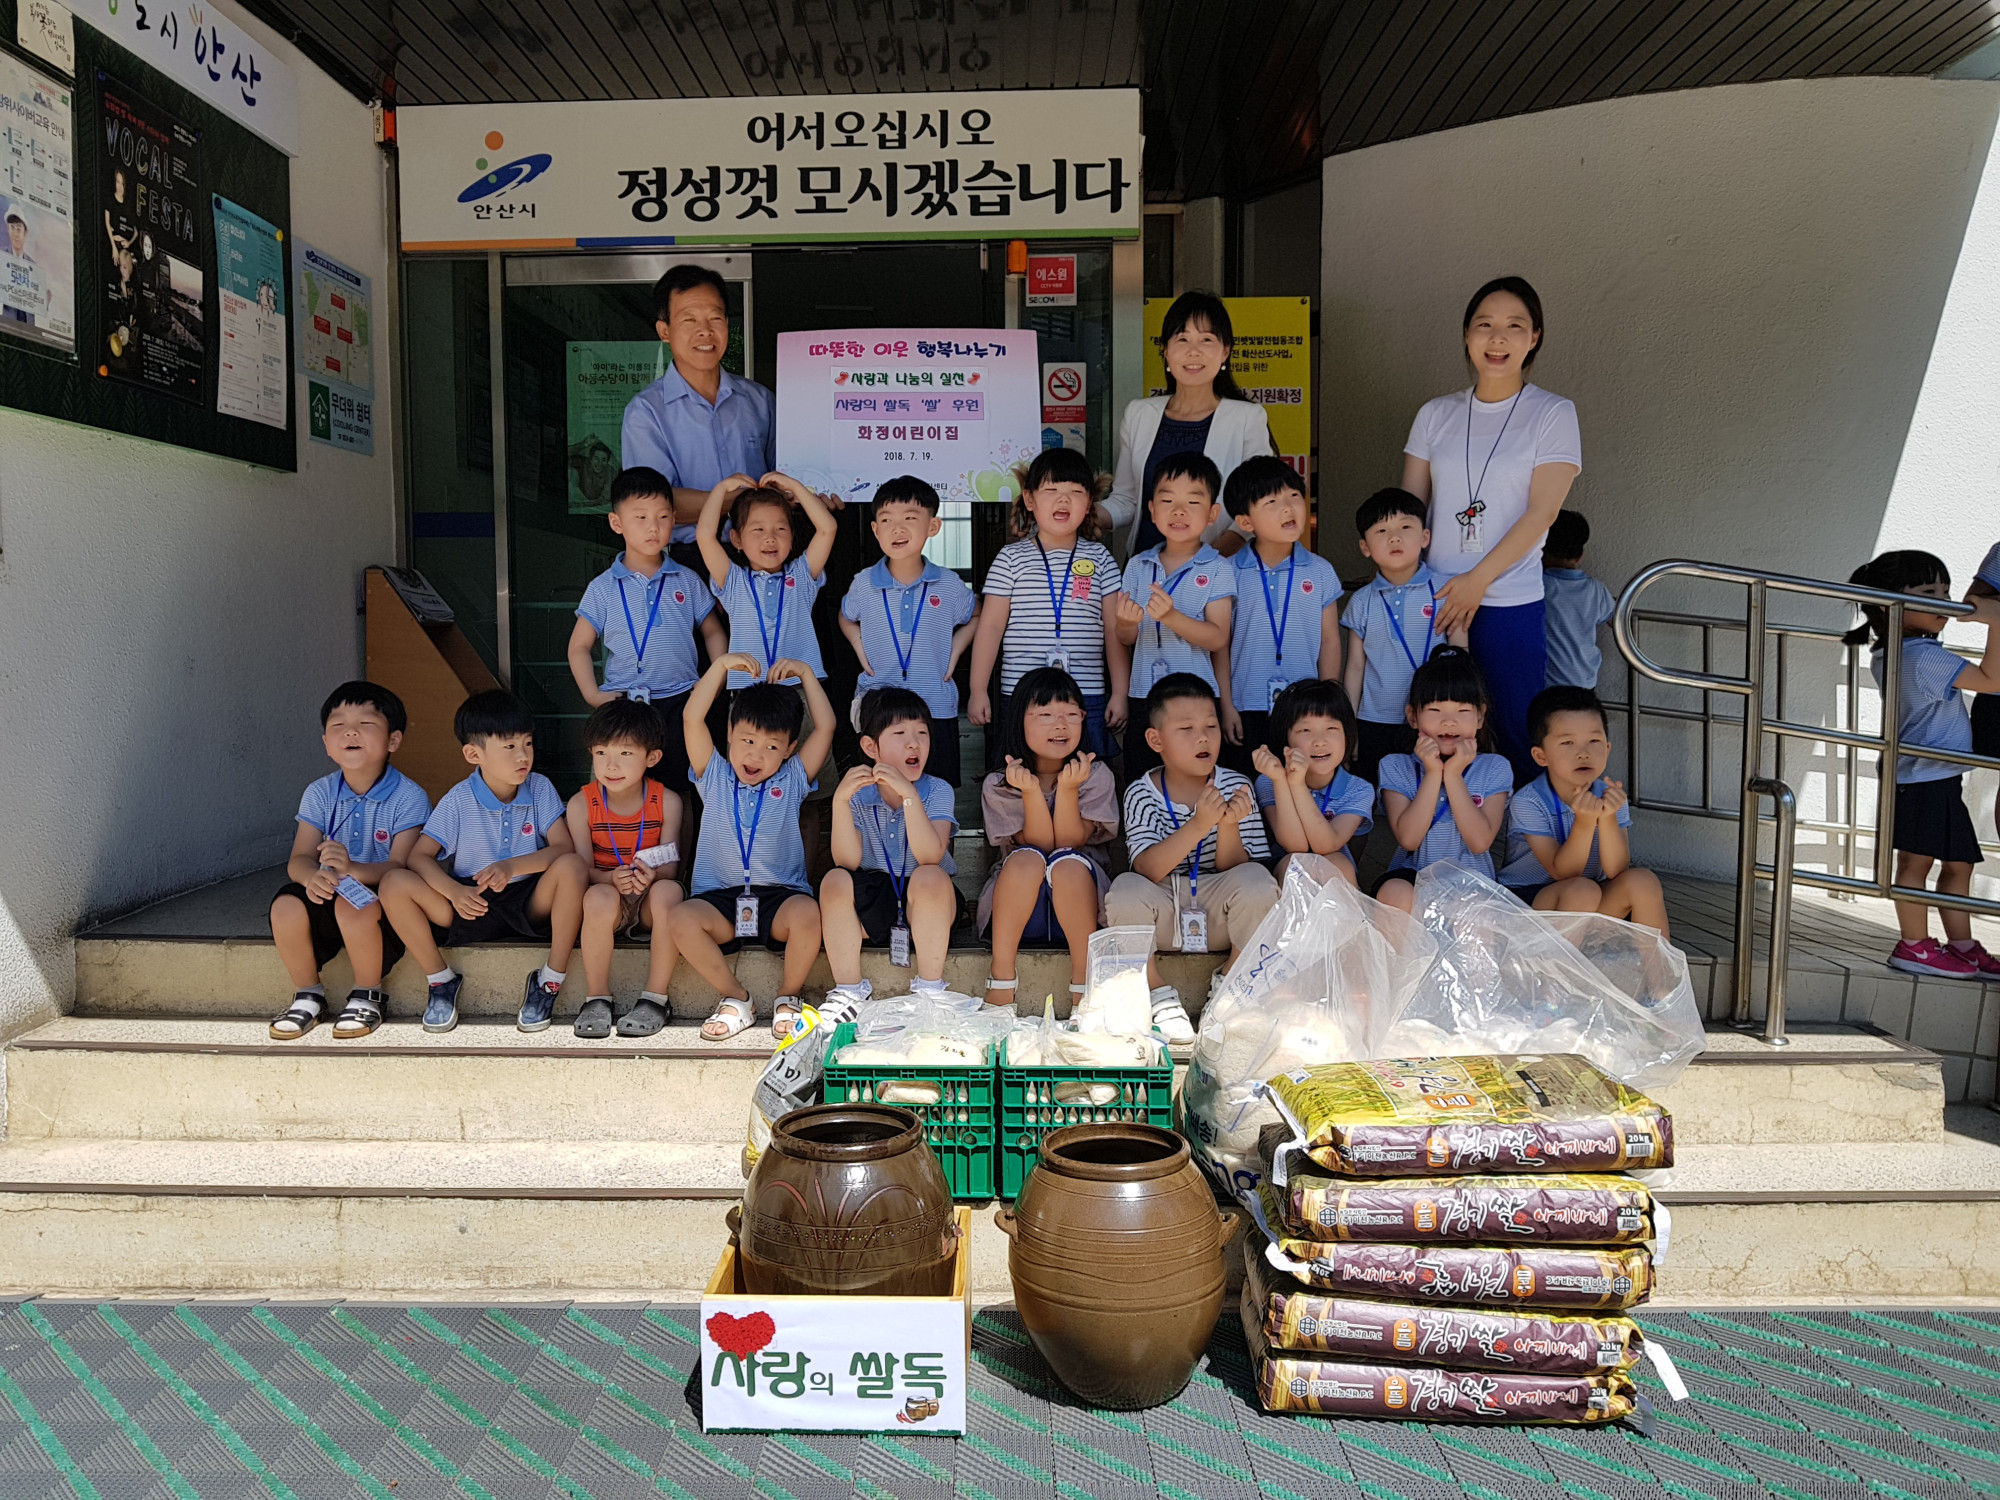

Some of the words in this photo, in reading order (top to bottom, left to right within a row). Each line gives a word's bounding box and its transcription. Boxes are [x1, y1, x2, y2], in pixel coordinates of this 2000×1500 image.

[195, 25, 262, 107] 안산
[51, 122, 65, 141] 안내
[747, 108, 995, 152] 어서오십시오
[105, 116, 173, 189] VOCAL
[617, 164, 778, 223] 정성껏
[794, 157, 1131, 220] 모시겠습니다
[136, 183, 194, 242] FESTA
[473, 202, 536, 219] 안산시
[1036, 268, 1067, 280] 에스원
[809, 341, 865, 358] 따뜻한
[873, 341, 909, 357] 이웃
[917, 341, 1007, 358] 행복나누기
[628, 363, 651, 372] 이름의
[1253, 363, 1269, 372] 위한
[578, 373, 629, 385] 아동수당이
[851, 372, 888, 386] 사랑과
[896, 372, 933, 386] 나눔의
[940, 372, 965, 386] 실천
[1251, 388, 1303, 404] 지원확정
[331, 393, 354, 419] 무더위
[356, 402, 371, 425] 쉼터
[835, 398, 877, 412] 사랑의
[884, 398, 910, 413] 쌀독
[952, 398, 979, 412] 후원
[858, 426, 959, 441] 화정어린이집
[884, 452, 906, 461] 2018.
[910, 452, 918, 461] 7.
[922, 452, 934, 461] 19.
[1544, 1137, 1616, 1156] 아끼바레
[1628, 1134, 1650, 1144] 20kg
[1534, 1208, 1608, 1227] 아끼바레
[1342, 1264, 1415, 1285] 아끼바레
[1513, 1339, 1587, 1360] 아끼바레
[1601, 1342, 1622, 1352] 20kg
[711, 1351, 833, 1398] 사랑의
[849, 1351, 947, 1398] 쌀독
[1504, 1387, 1578, 1405] 아끼바레
